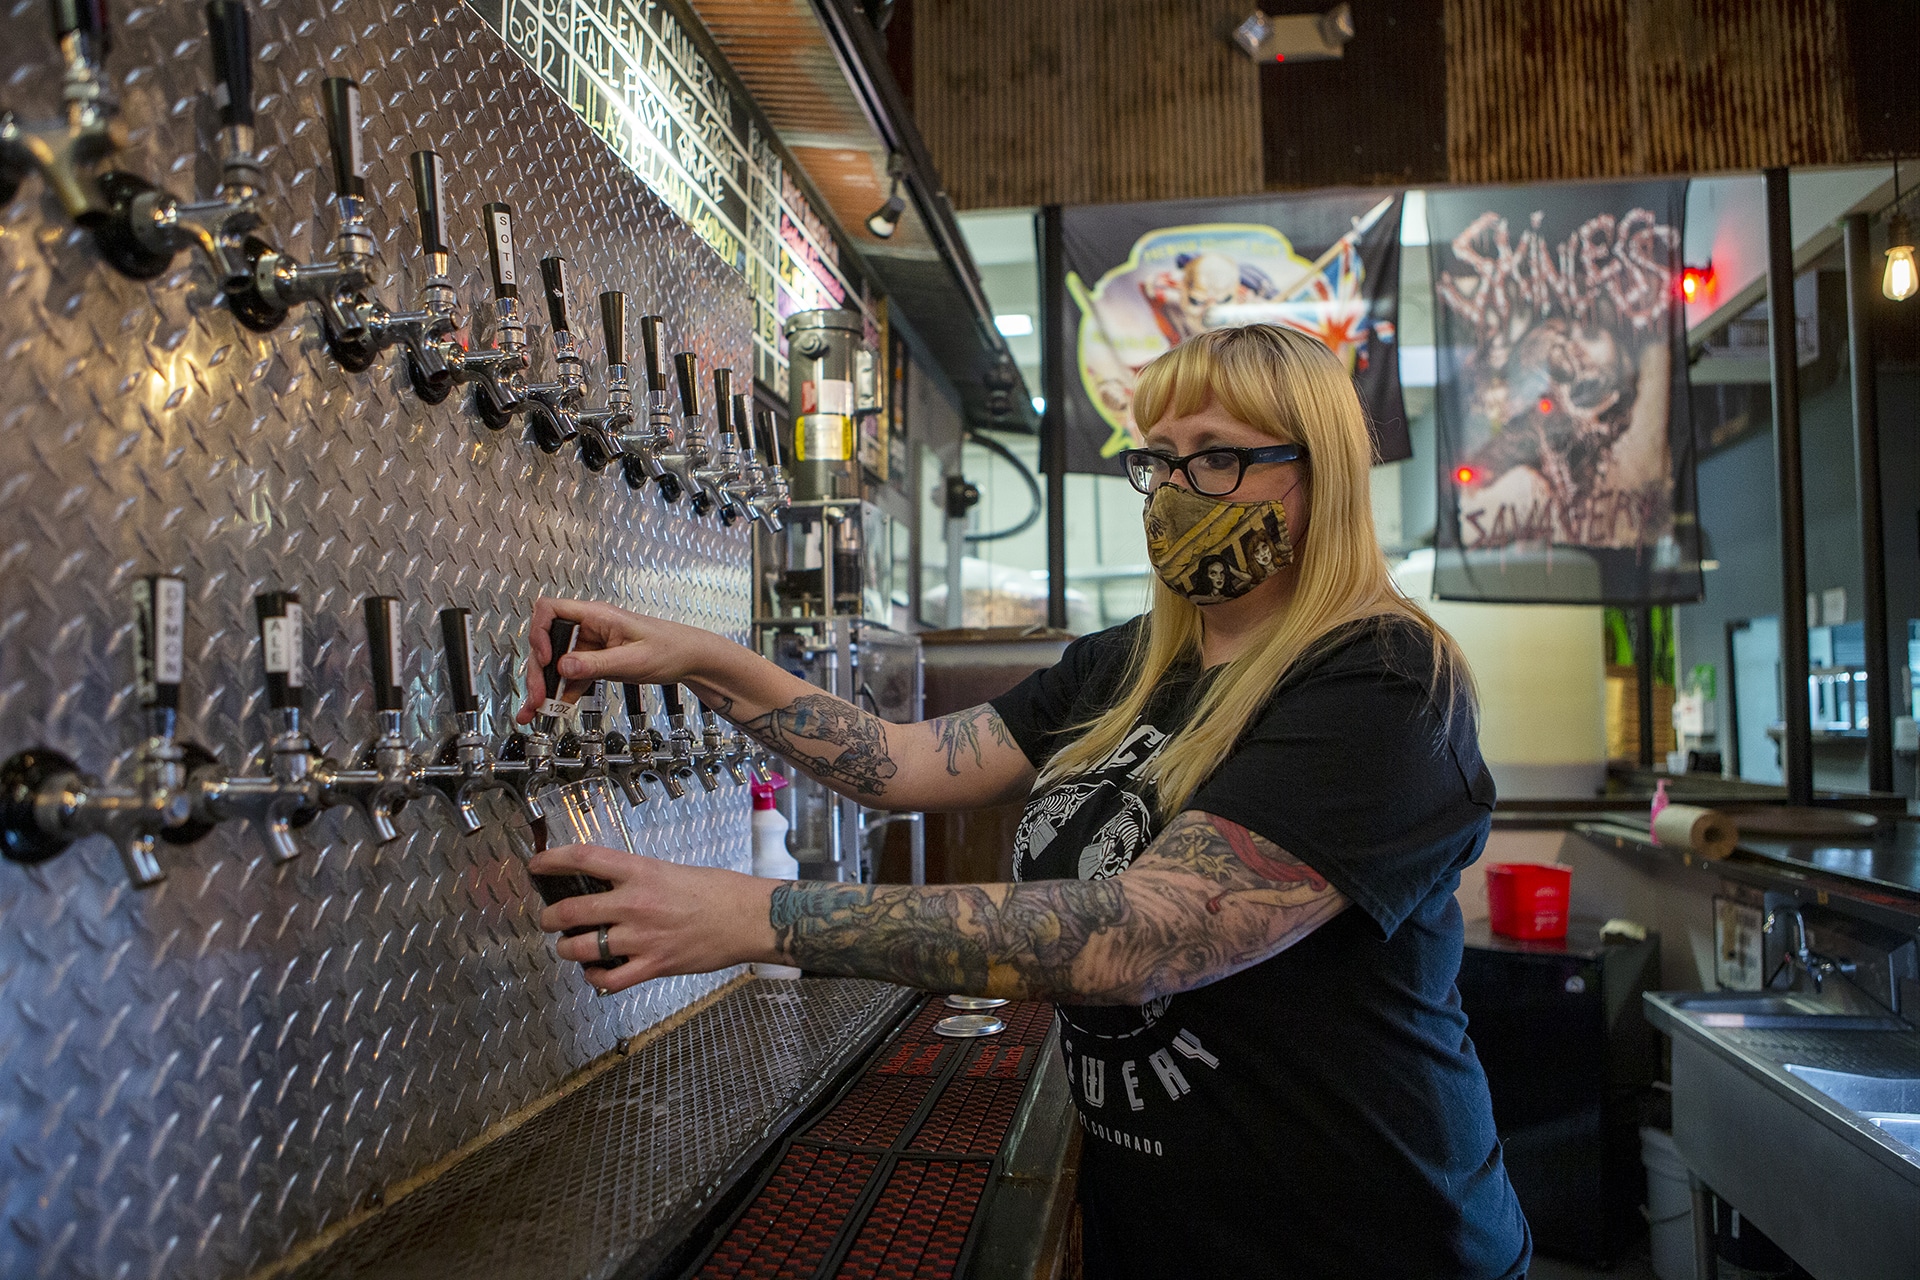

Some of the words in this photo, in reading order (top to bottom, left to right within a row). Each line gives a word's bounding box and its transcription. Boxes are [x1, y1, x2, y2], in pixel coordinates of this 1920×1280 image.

[509, 0, 538, 59] 6.8
[542, 39, 566, 89] 21
[575, 12, 621, 89] FALL
[623, 66, 673, 151] FROM
[676, 131, 726, 204] GRACE
[648, 41, 702, 133] ANGEL
[701, 109, 744, 182] STOUT
[499, 215, 513, 281] SOTS
[1091, 1120, 1163, 1157] COLORADO
